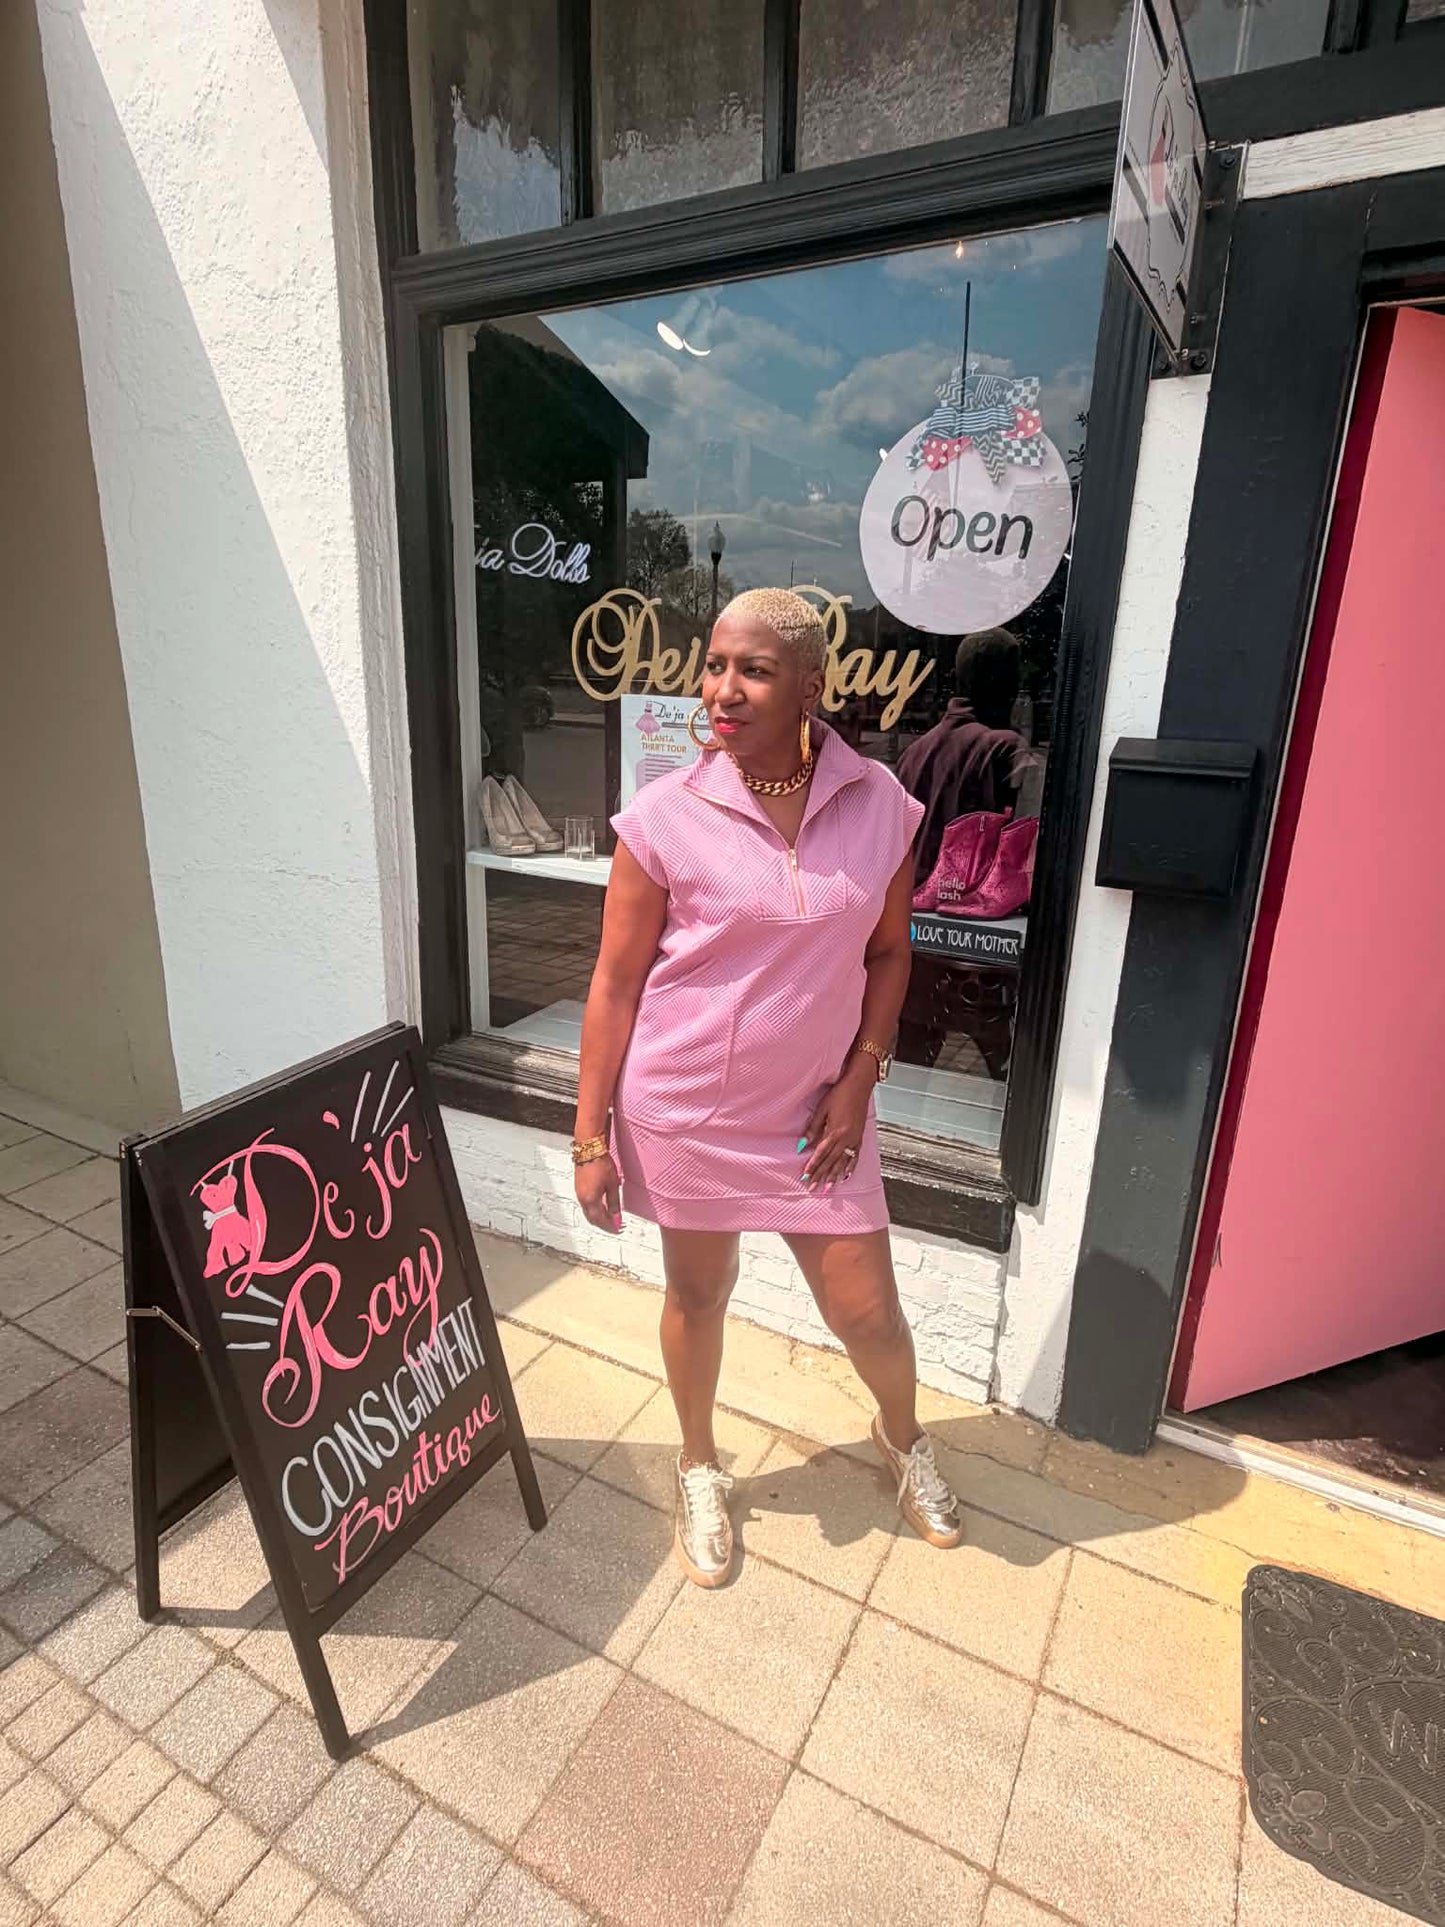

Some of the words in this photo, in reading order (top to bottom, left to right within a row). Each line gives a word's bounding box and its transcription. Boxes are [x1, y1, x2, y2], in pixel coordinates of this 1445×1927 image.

[890, 494, 1034, 561] Open
[509, 523, 591, 583] Dolls
[641, 734, 675, 743] ATLANTA
[666, 745, 687, 753] TOUR
[938, 877, 966, 890] hello
[938, 889, 961, 900] lash
[917, 925, 944, 943] LOVE
[946, 928, 972, 949] YOUR
[974, 933, 1019, 955] MOTHER
[261, 1228, 443, 1428] Ray
[281, 1298, 488, 1537] CONSIGNMENT
[314, 1393, 502, 1585] Boutique
